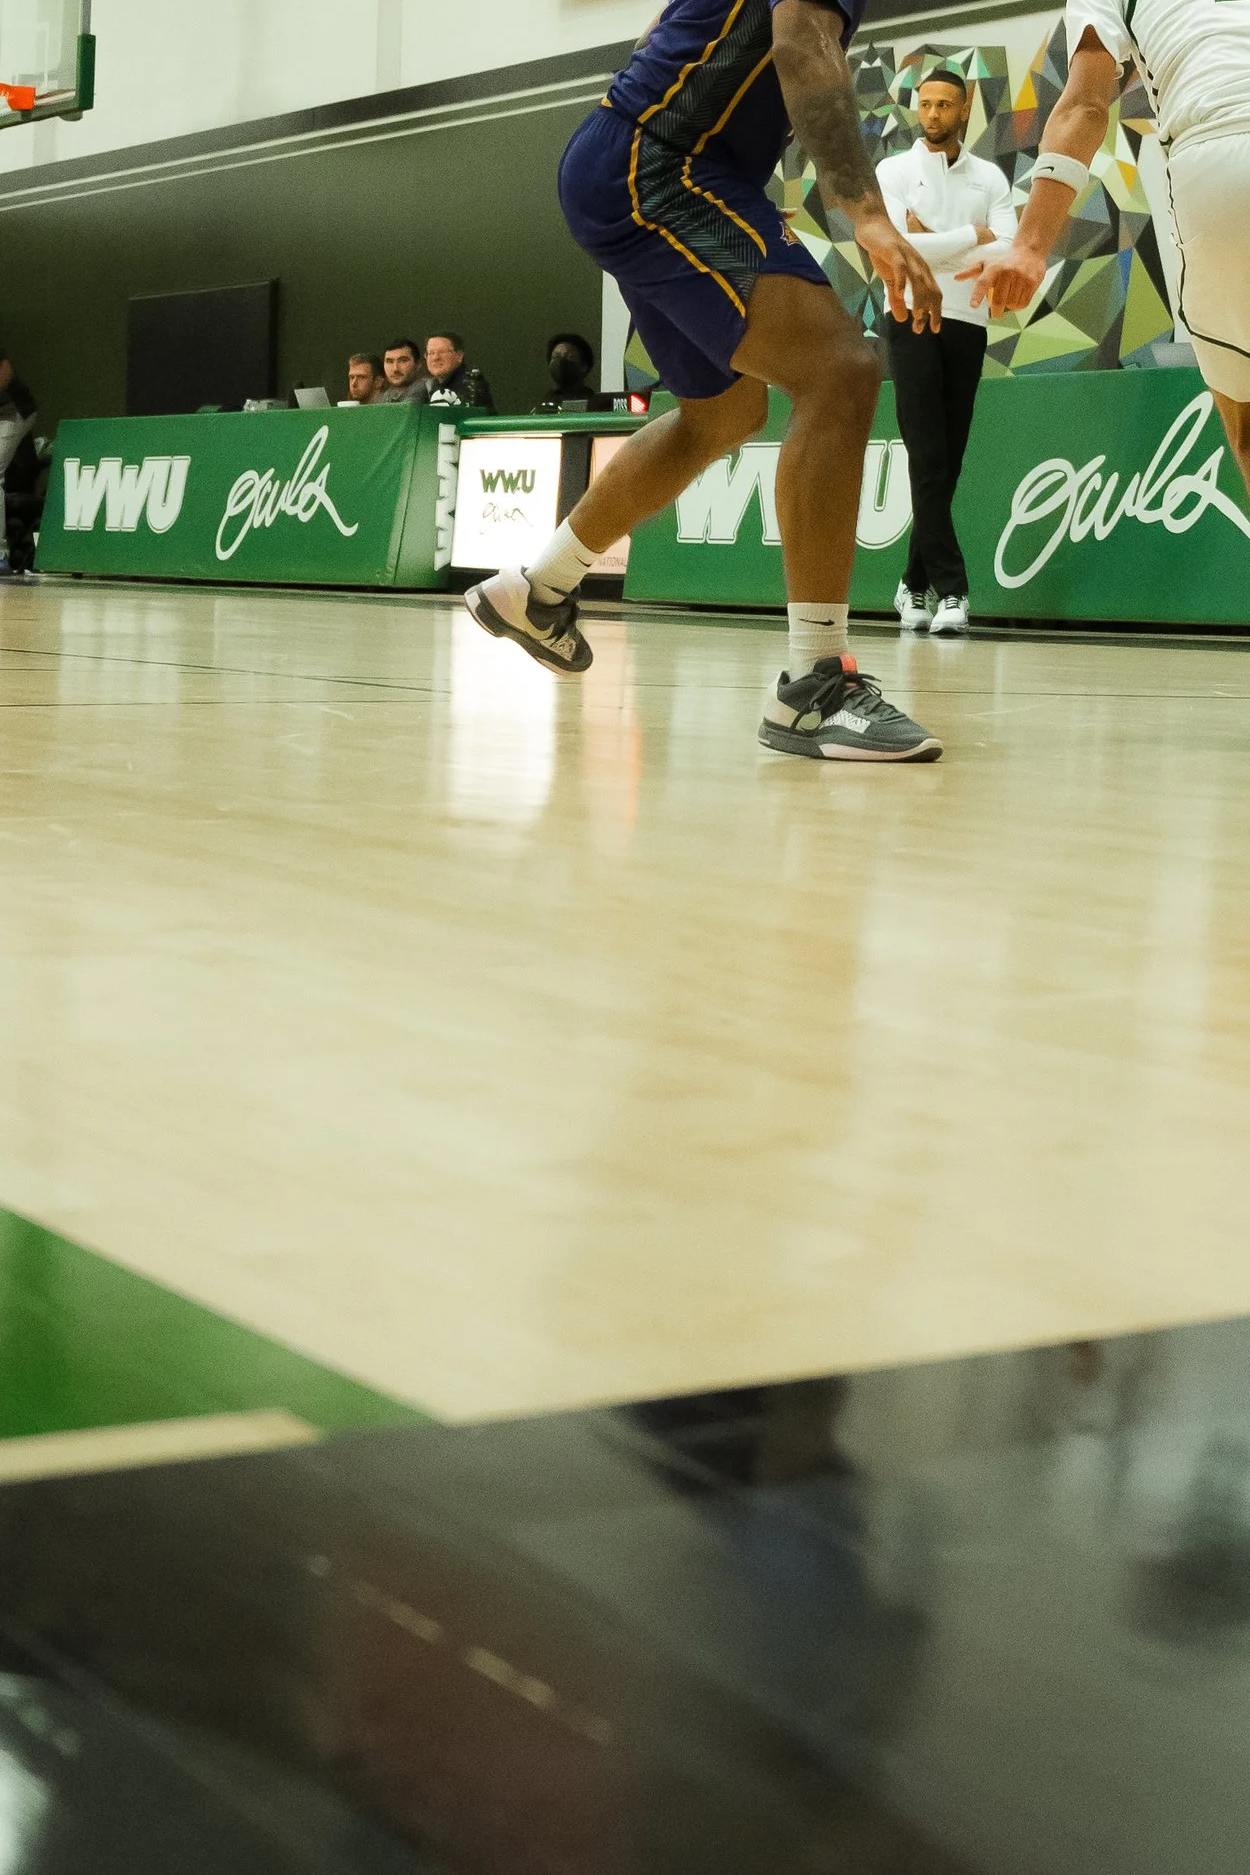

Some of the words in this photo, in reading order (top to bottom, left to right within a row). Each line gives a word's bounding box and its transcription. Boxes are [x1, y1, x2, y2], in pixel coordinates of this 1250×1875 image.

[63, 455, 191, 534] WWU
[480, 469, 536, 493] WWU
[674, 441, 914, 549] WU
